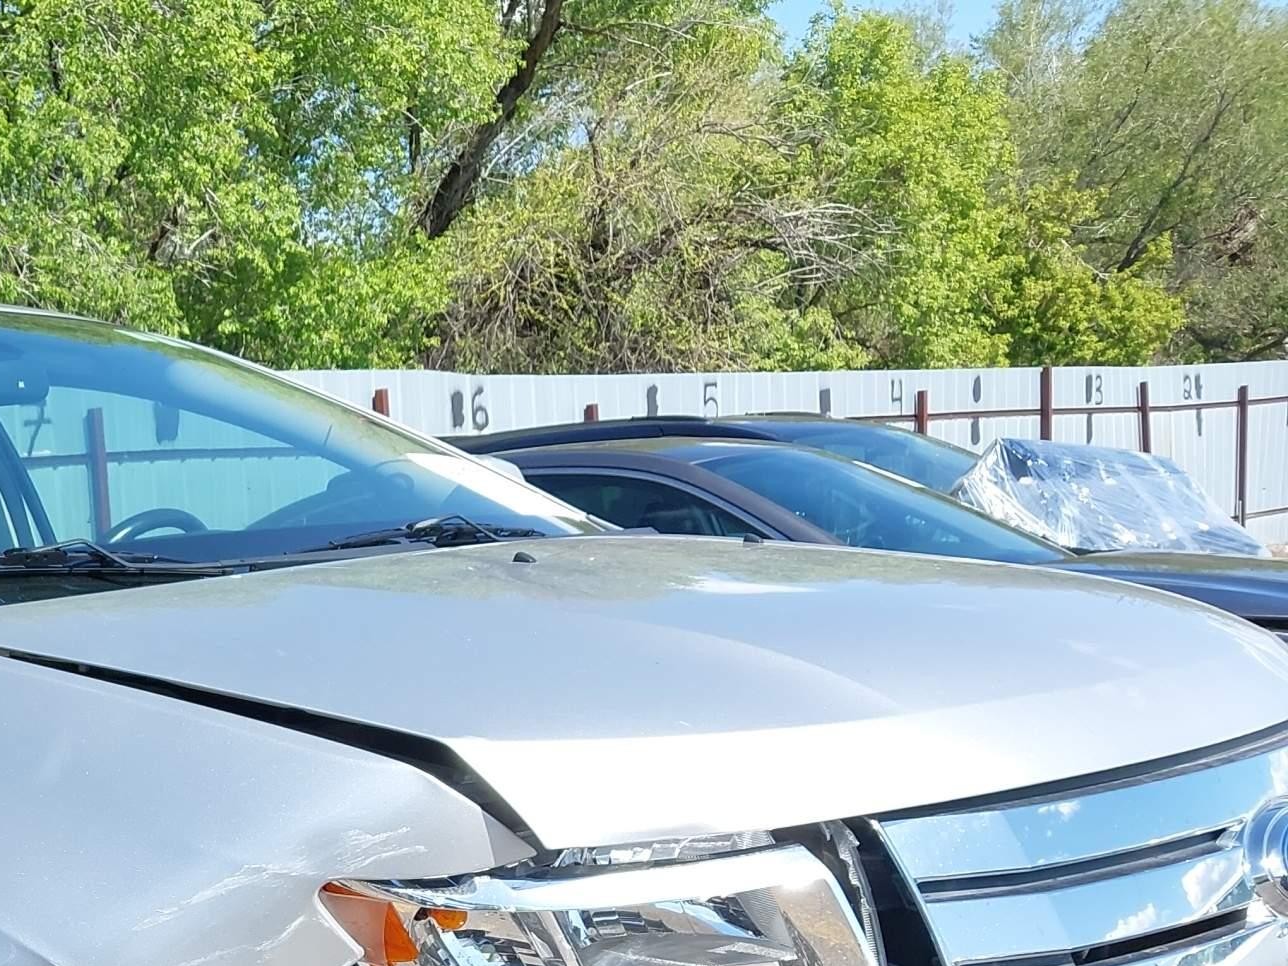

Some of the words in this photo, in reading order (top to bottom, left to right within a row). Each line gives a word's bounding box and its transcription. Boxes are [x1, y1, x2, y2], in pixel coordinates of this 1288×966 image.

[703, 381, 719, 419] 5
[890, 378, 903, 415] 4
[1095, 374, 1104, 406] 3
[471, 386, 490, 432] 6
